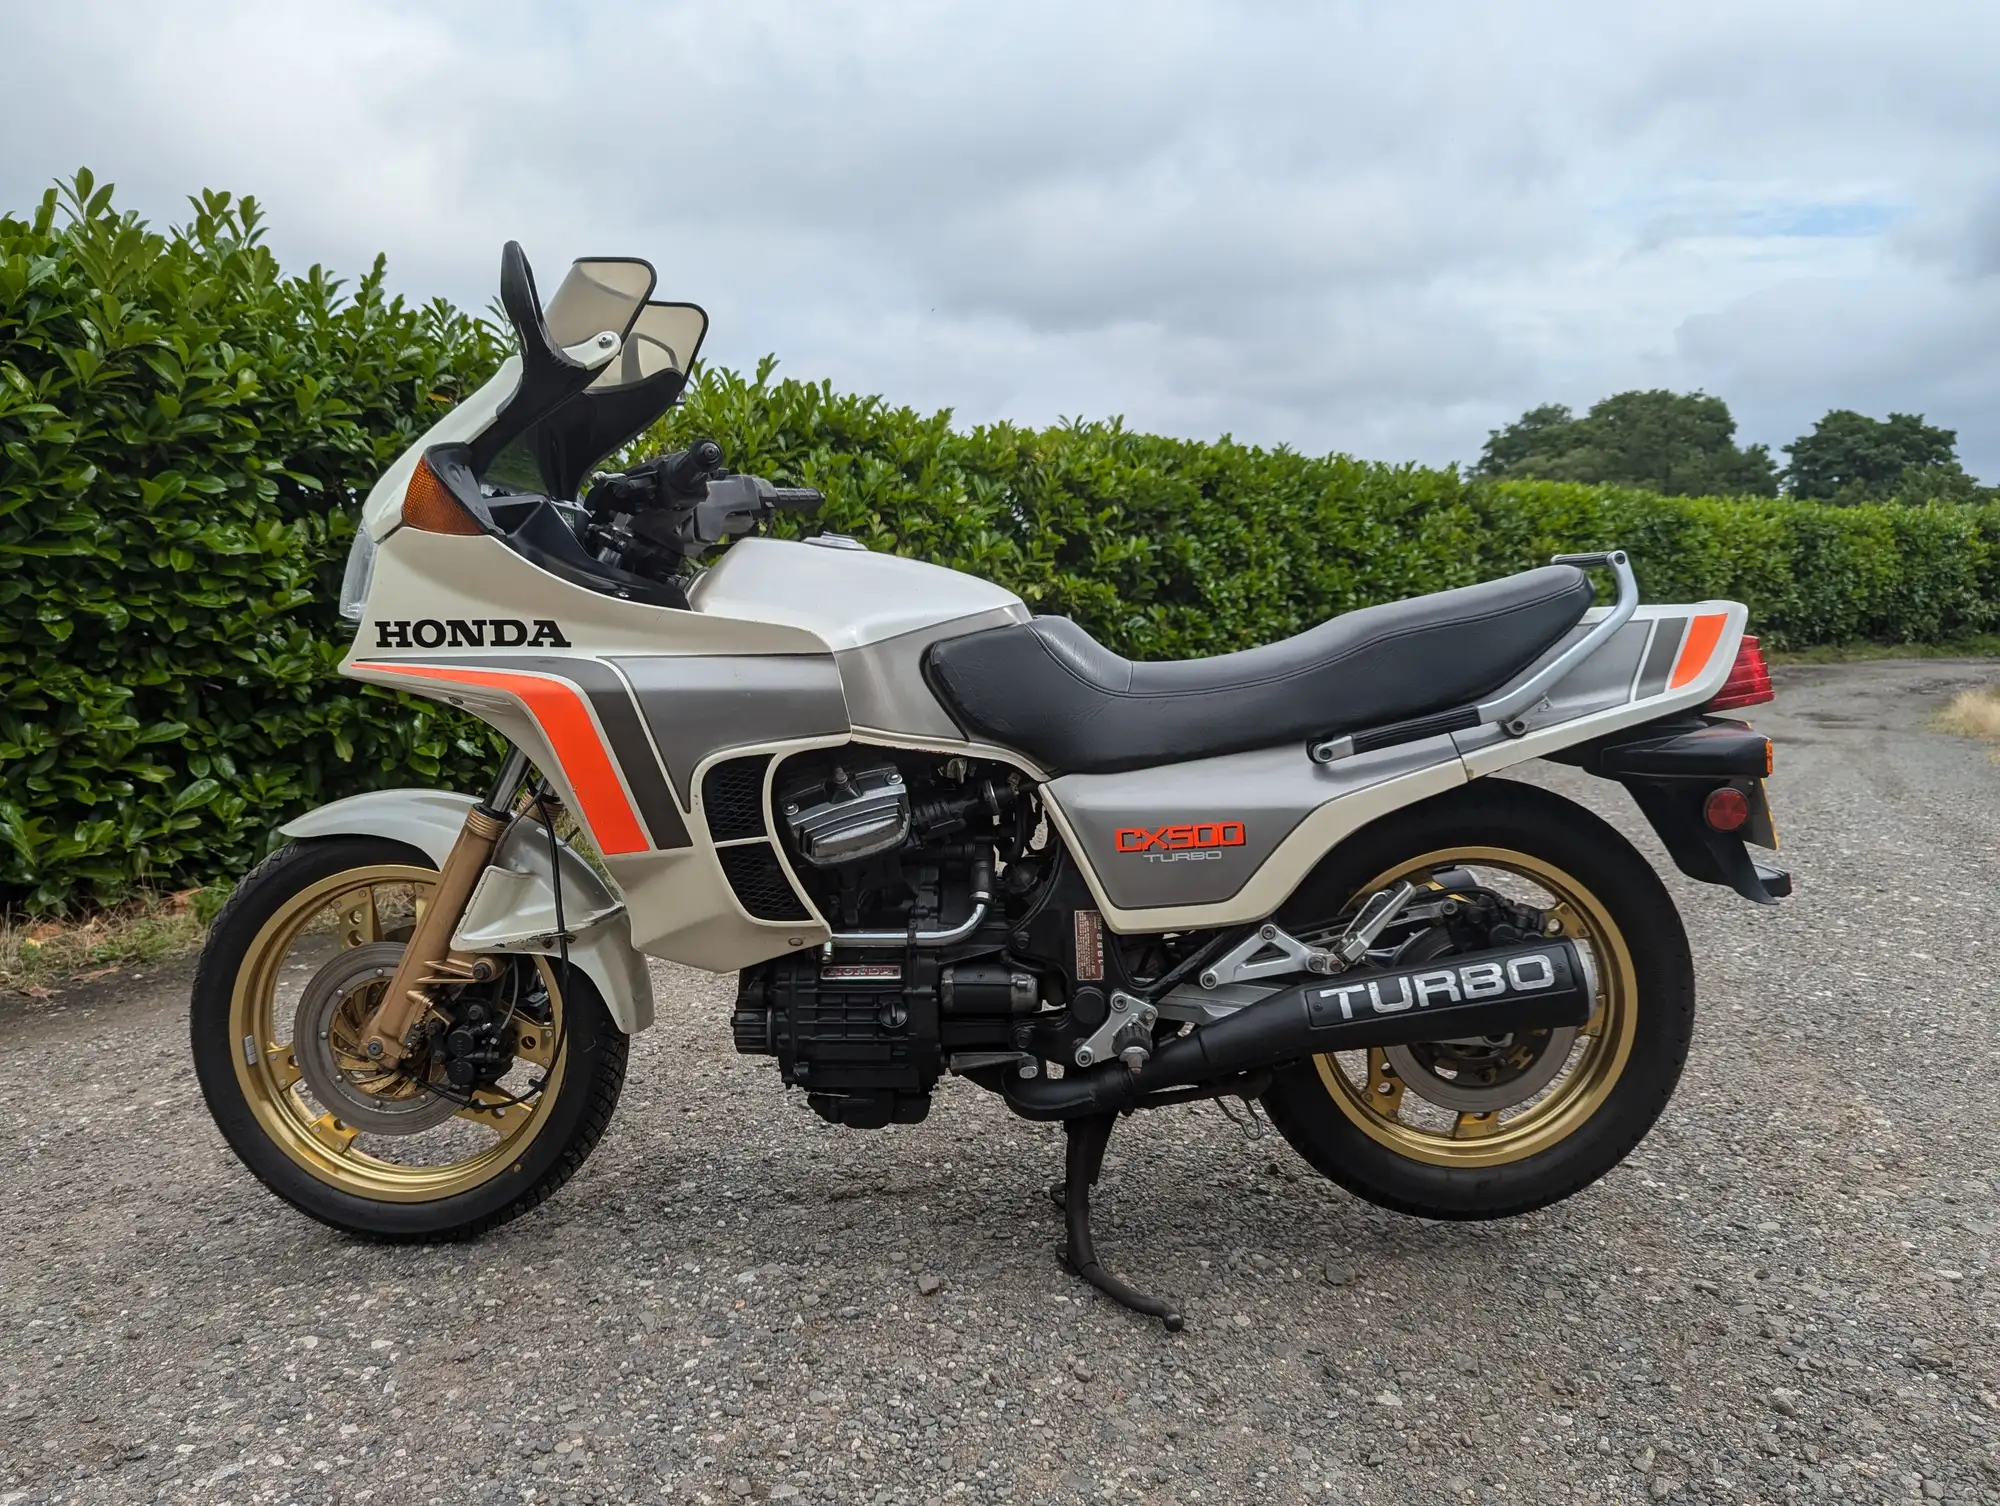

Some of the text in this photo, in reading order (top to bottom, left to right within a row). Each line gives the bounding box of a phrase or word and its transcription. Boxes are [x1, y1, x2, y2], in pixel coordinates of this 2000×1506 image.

[374, 619, 572, 648] HONDA
[1115, 821, 1246, 852] CX500
[1143, 850, 1222, 863] TURBO
[1319, 954, 1555, 1019] TURBO
